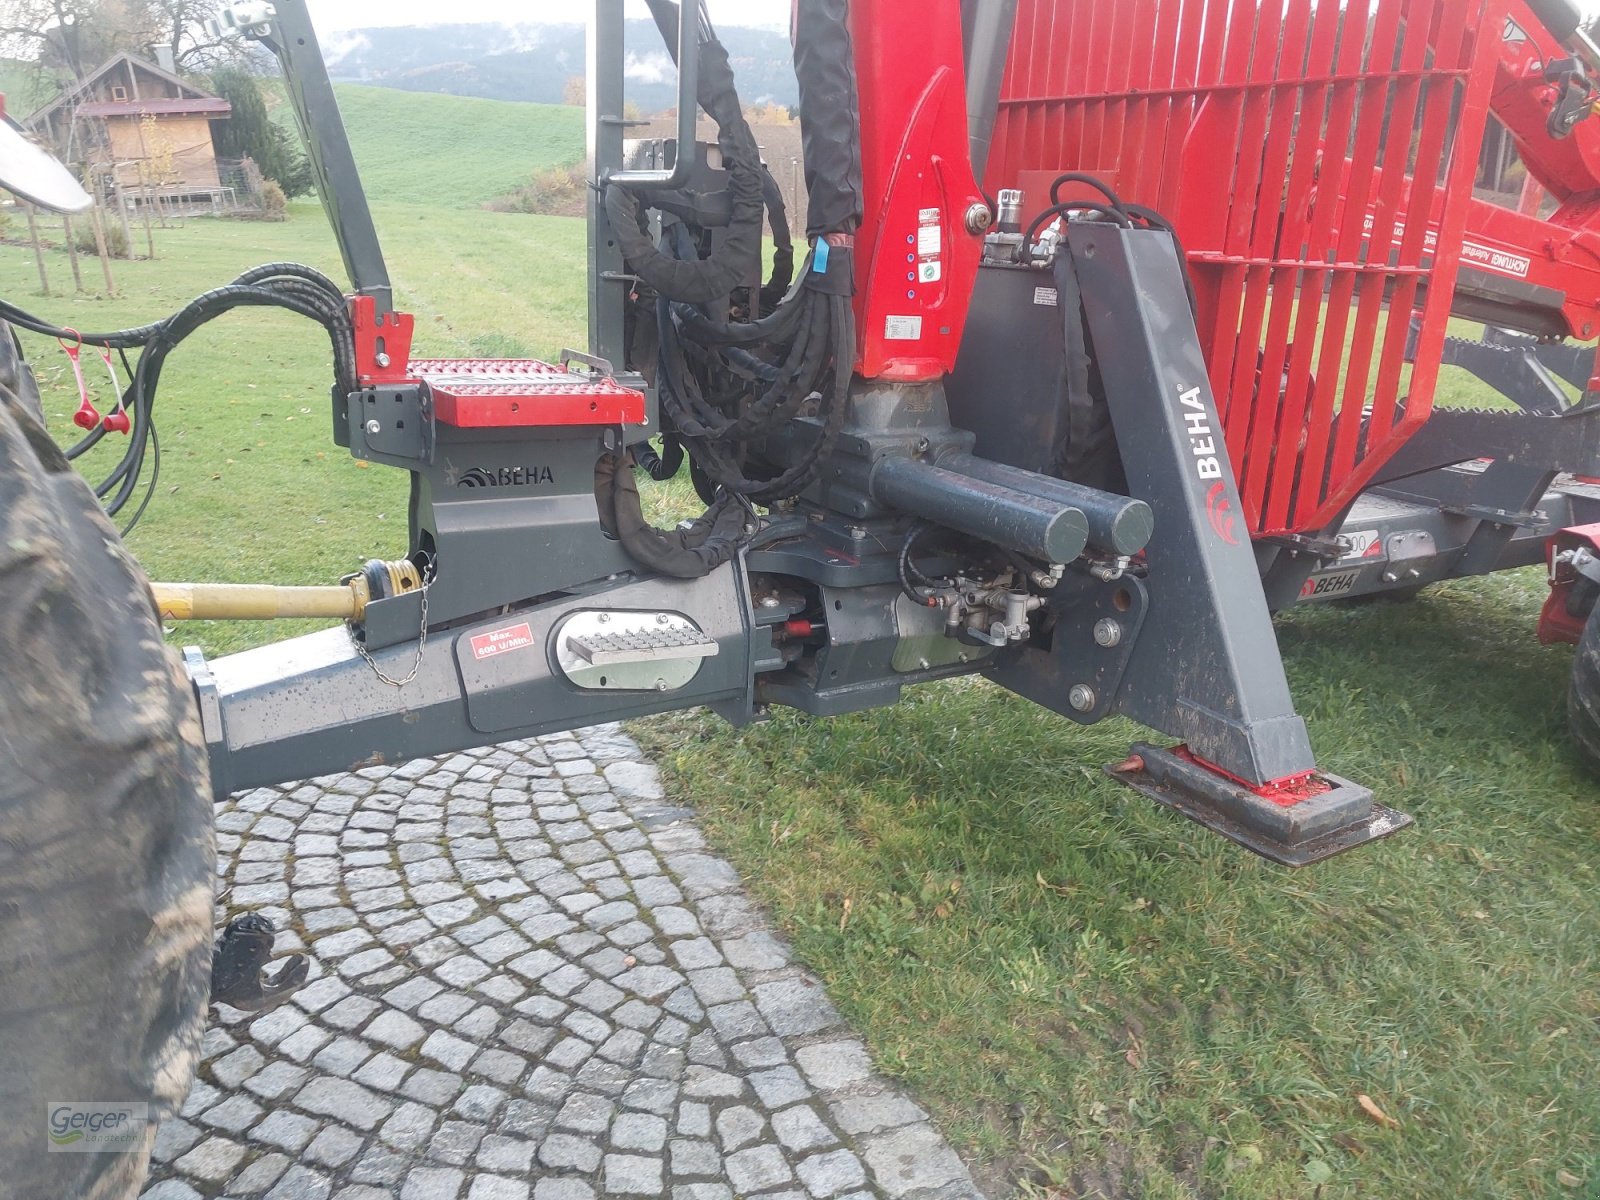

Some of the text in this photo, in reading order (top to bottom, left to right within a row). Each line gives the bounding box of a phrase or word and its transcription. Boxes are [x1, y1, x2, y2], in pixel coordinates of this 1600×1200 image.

[498, 465, 554, 486] BEHA
[1313, 573, 1356, 595] BEHA
[489, 631, 513, 642] Max.
[478, 645, 497, 655] 600
